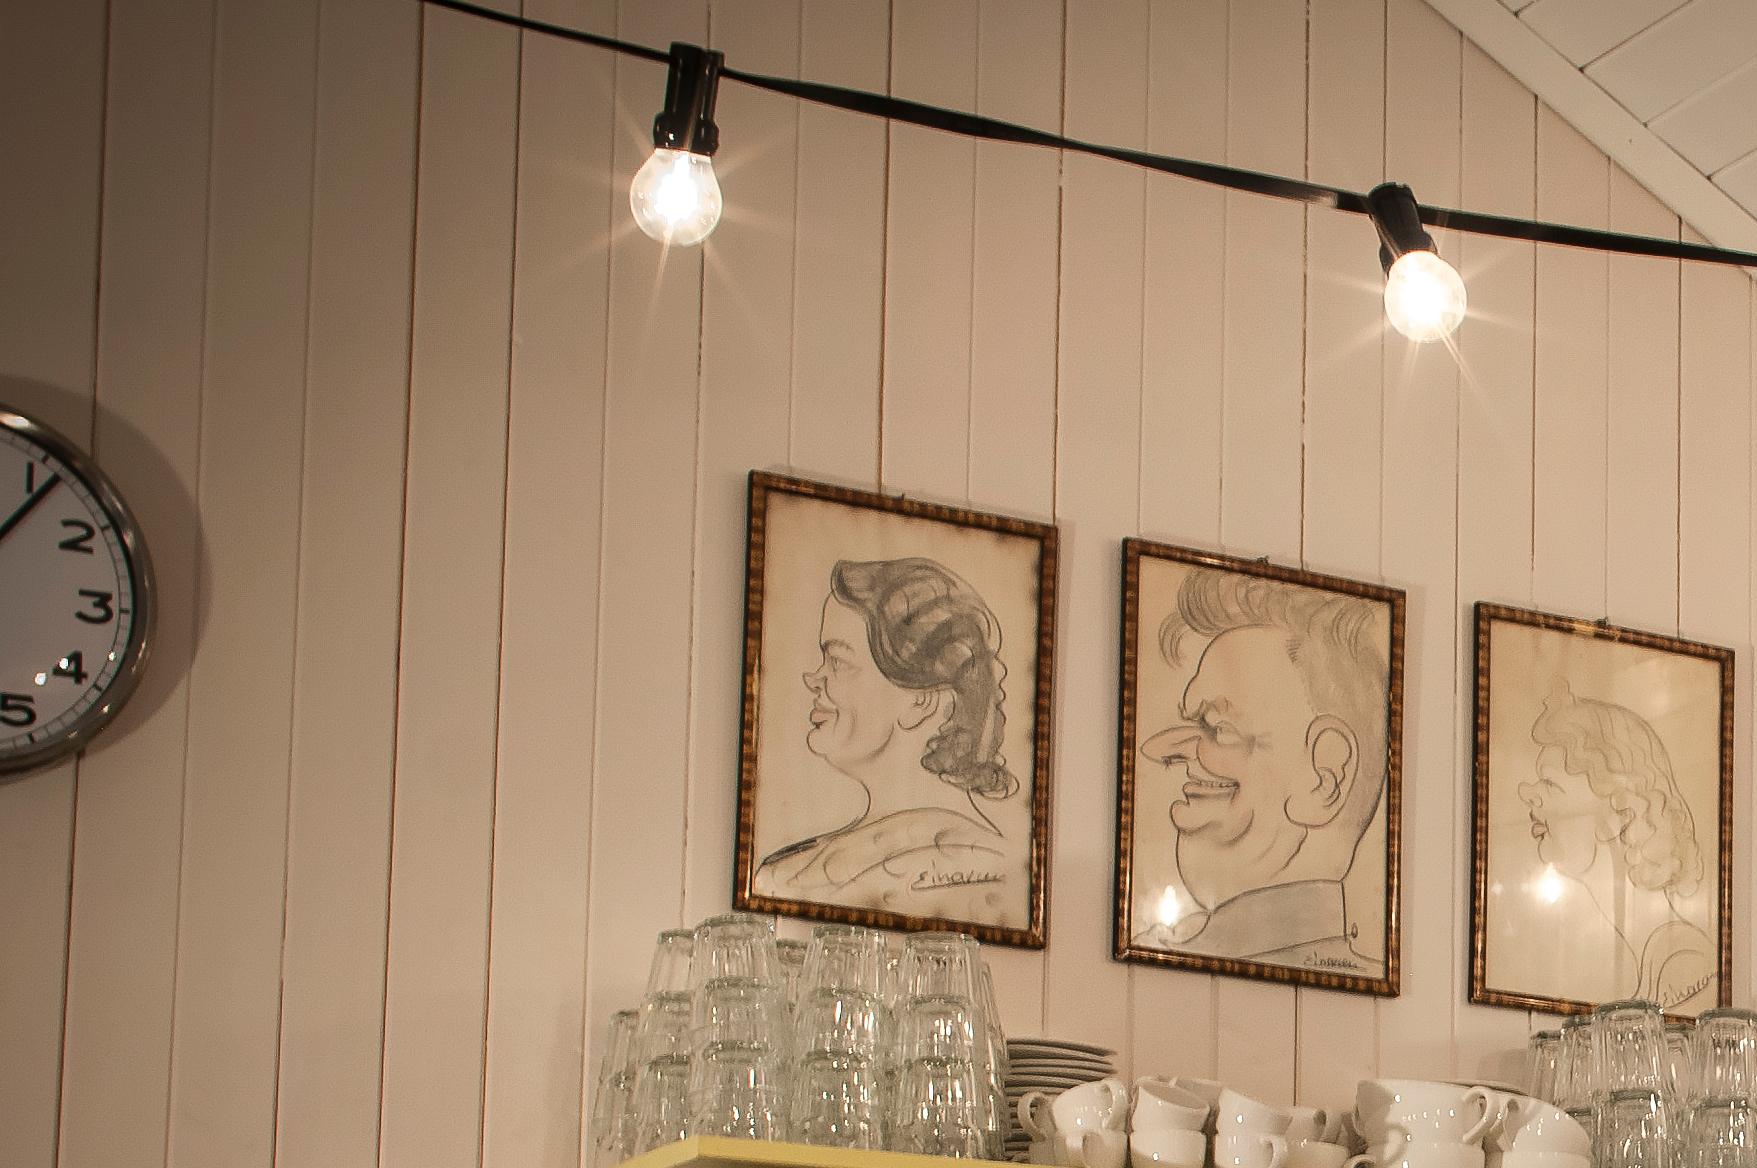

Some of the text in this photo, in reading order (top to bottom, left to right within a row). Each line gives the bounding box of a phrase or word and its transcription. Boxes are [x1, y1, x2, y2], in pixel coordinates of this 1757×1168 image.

[26, 461, 34, 494] 1
[58, 518, 96, 554] 2
[75, 588, 114, 625] 3
[52, 649, 88, 685] 4
[0, 692, 36, 727] 5
